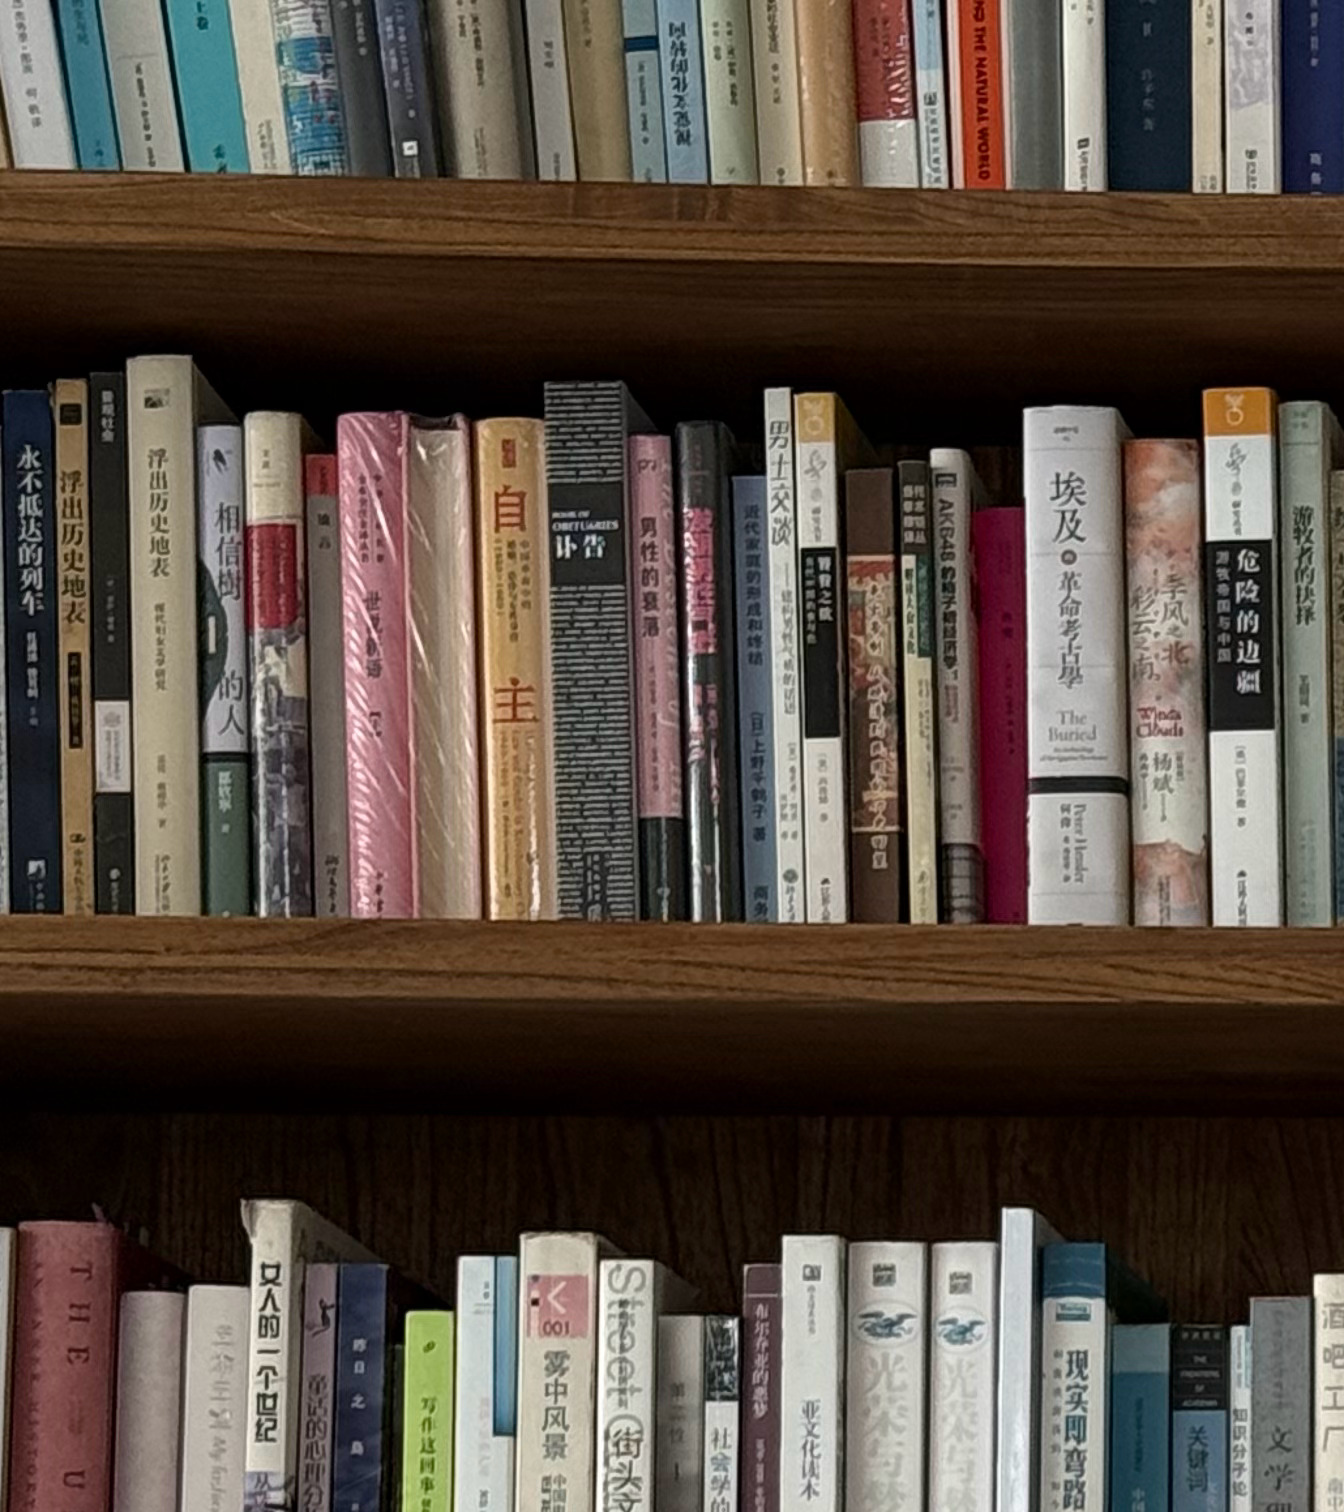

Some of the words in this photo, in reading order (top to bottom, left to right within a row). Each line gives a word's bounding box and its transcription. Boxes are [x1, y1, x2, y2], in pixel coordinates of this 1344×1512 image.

[975, 27, 986, 54] THE
[976, 57, 989, 124] NATURAL
[976, 128, 990, 180] WORLD
[147, 449, 170, 577] 浮出历史地表
[495, 485, 527, 533] 自
[769, 420, 792, 546] 男士交谈
[17, 445, 44, 616] 永不抵达的列车
[60, 470, 86, 624] 浮出历史地表
[555, 535, 606, 559] 讣告
[640, 517, 659, 637] 男性的衰落
[1236, 548, 1260, 693] 危险的边疆
[493, 677, 539, 724] 主
[1048, 725, 1096, 742] Buried
[1056, 710, 1087, 725] The
[67, 1261, 93, 1366] THE
[254, 1262, 282, 1443] 女人的一个世纪
[543, 1320, 570, 1336] 001
[420, 1397, 436, 1495] 写作这回事
[542, 1351, 569, 1459] 雾中风景
[1063, 1351, 1087, 1511] 现实即弯路
[1188, 1426, 1210, 1492] 关键词
[1232, 1408, 1248, 1496] 知识分子论
